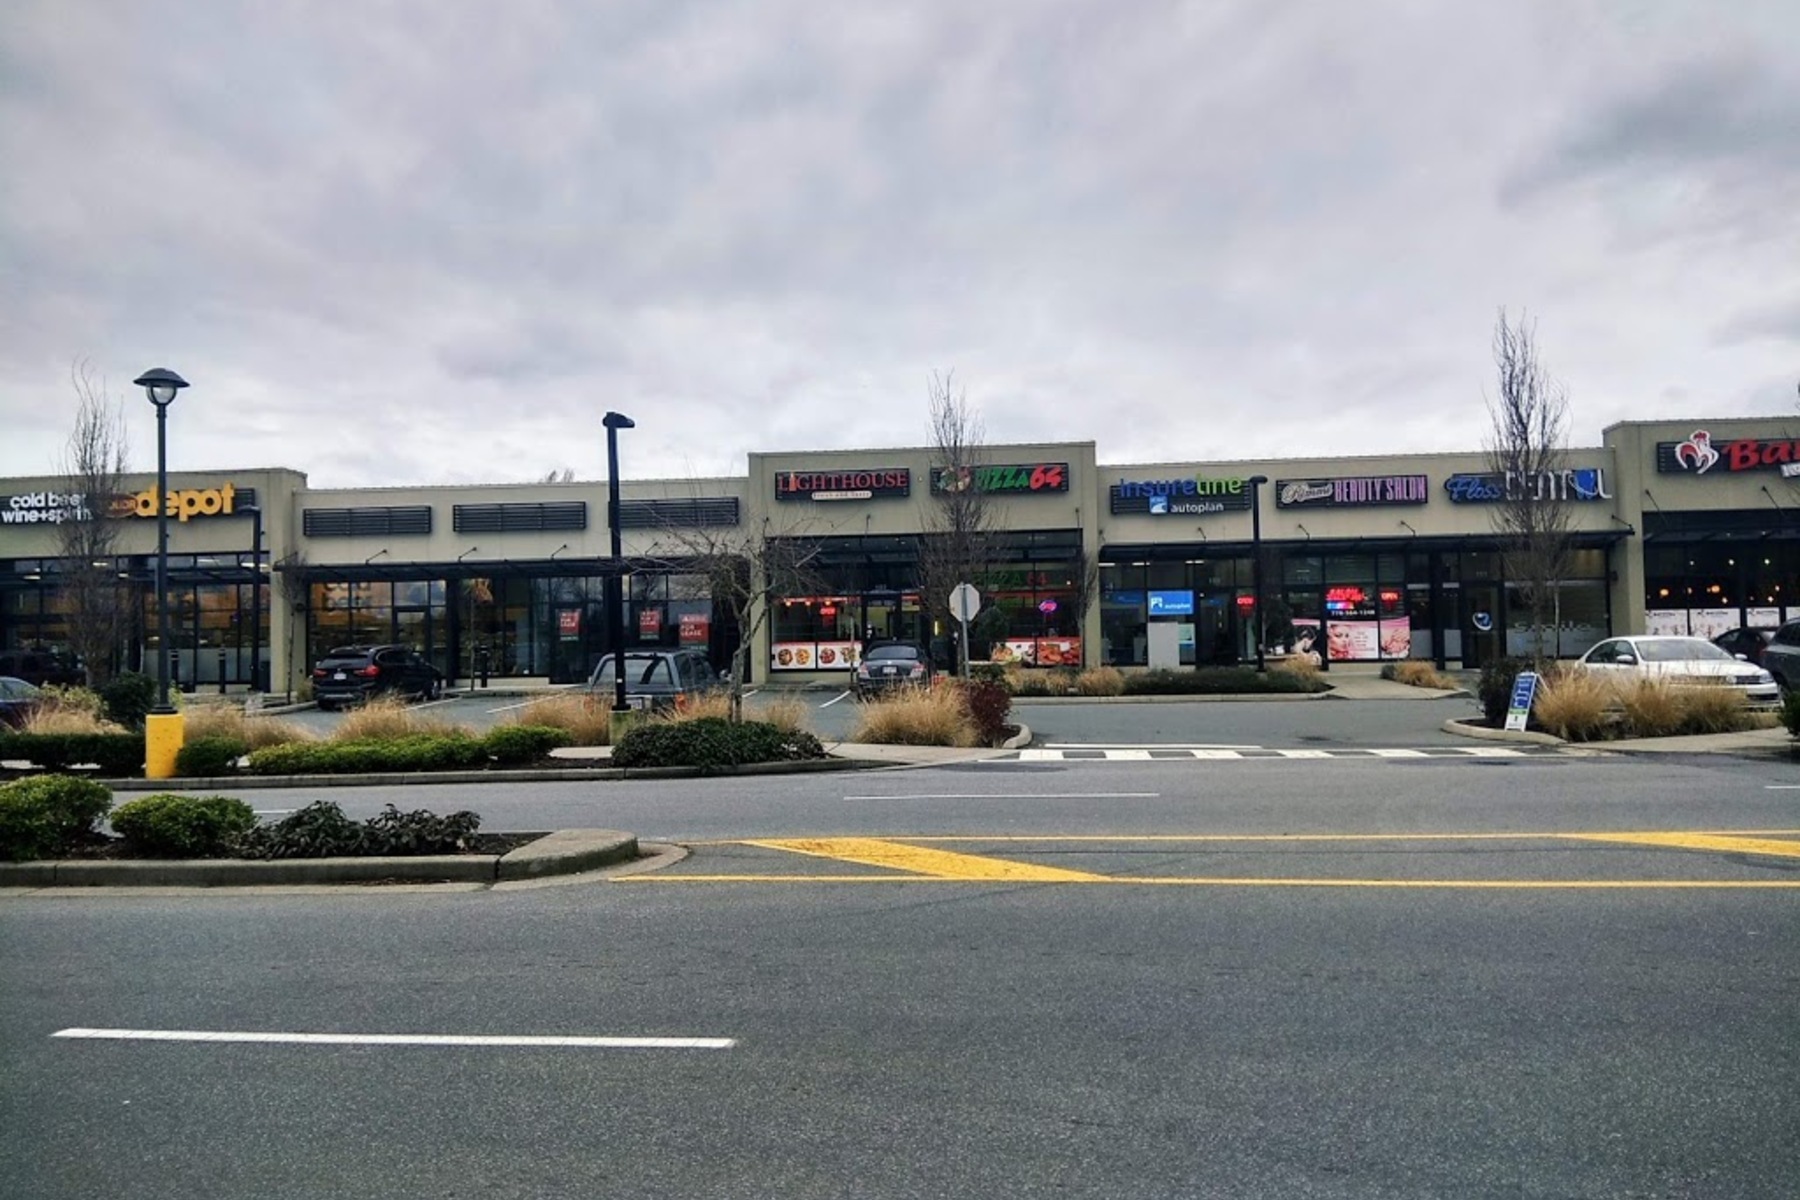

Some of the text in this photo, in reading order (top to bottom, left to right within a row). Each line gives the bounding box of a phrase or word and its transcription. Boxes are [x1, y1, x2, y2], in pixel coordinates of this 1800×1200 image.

[778, 471, 908, 492] LIGHTHOUSE
[975, 465, 1062, 490] PIZZA 64
[1119, 473, 1242, 498] insureline
[1334, 478, 1381, 502] BEAUTY
[1385, 476, 1427, 501] SALON
[1446, 468, 1613, 501] Floss DNTAL
[10, 492, 45, 508] cold
[134, 481, 235, 522] depot
[1170, 501, 1225, 514] autoplan
